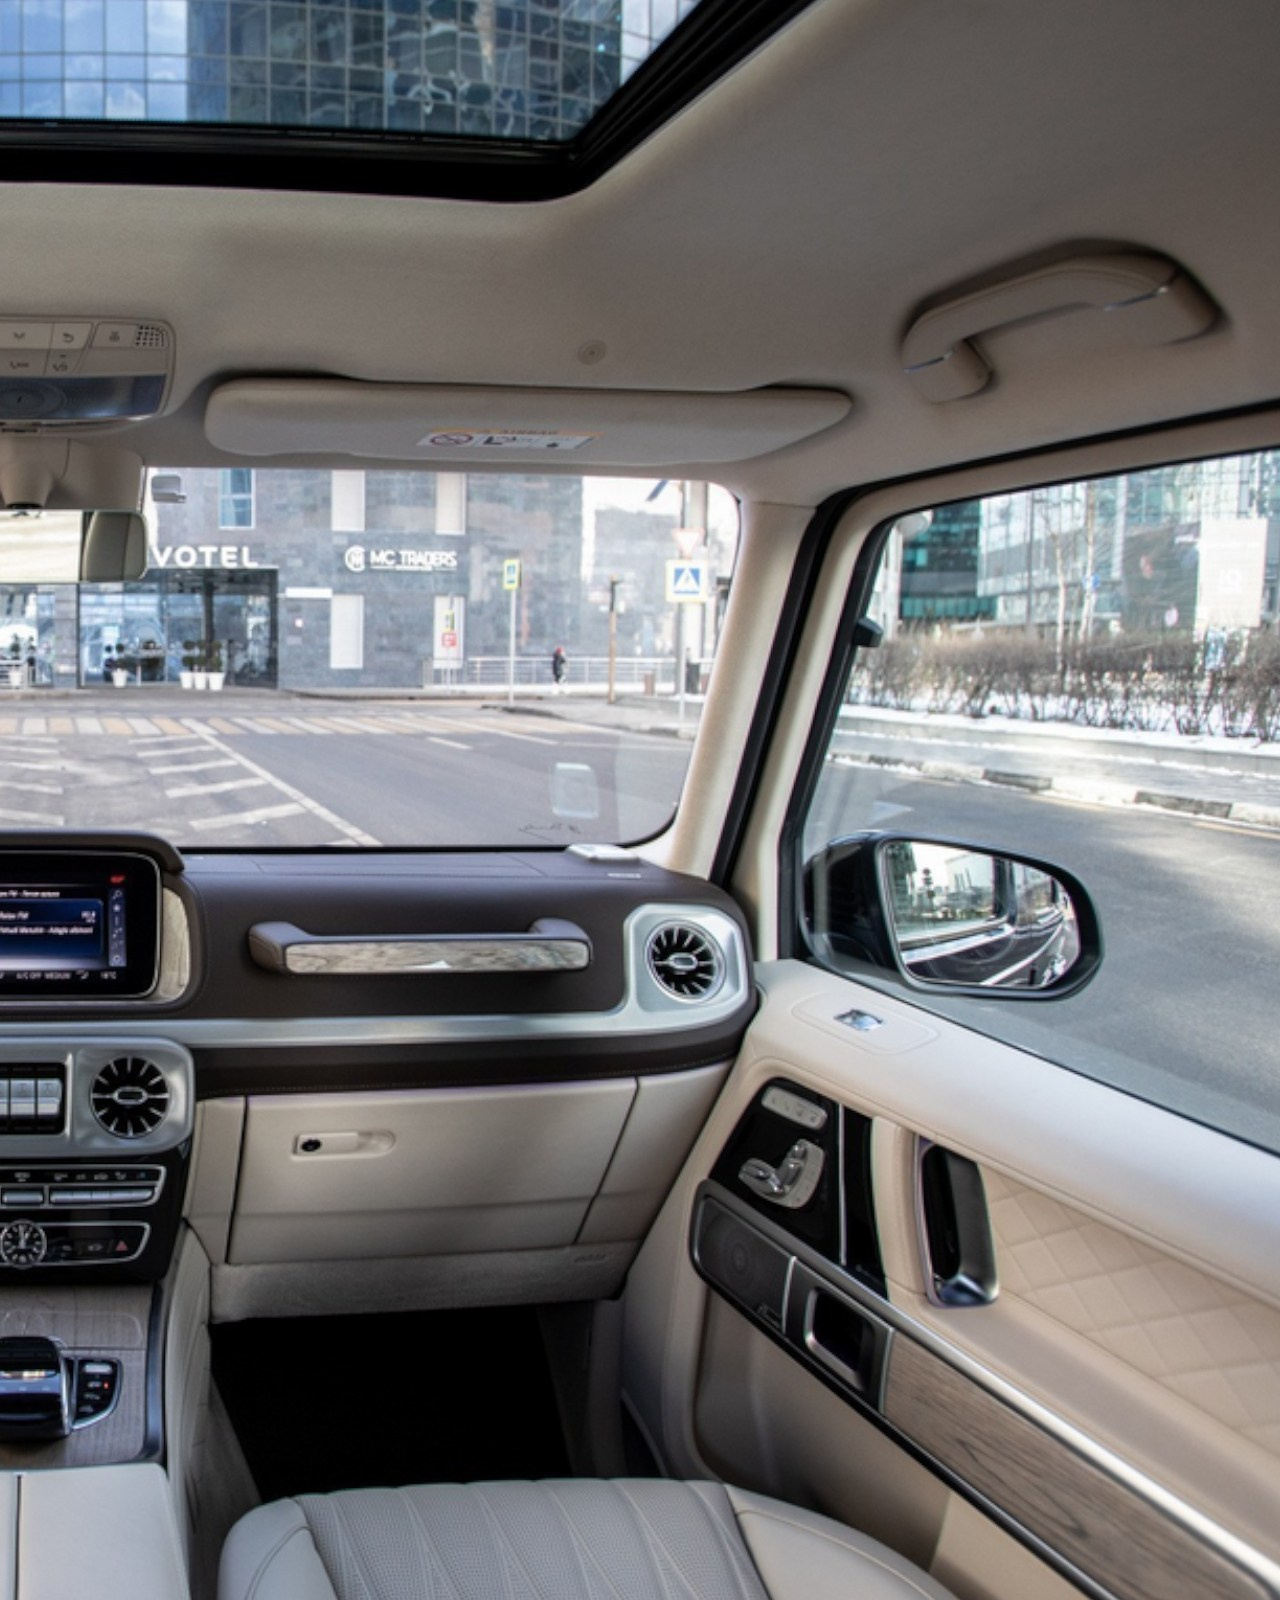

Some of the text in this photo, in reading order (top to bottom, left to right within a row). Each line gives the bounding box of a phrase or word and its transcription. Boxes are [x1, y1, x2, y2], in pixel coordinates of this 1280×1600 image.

[151, 546, 259, 568] VOTEL
[370, 550, 458, 568] MC TRADERS
